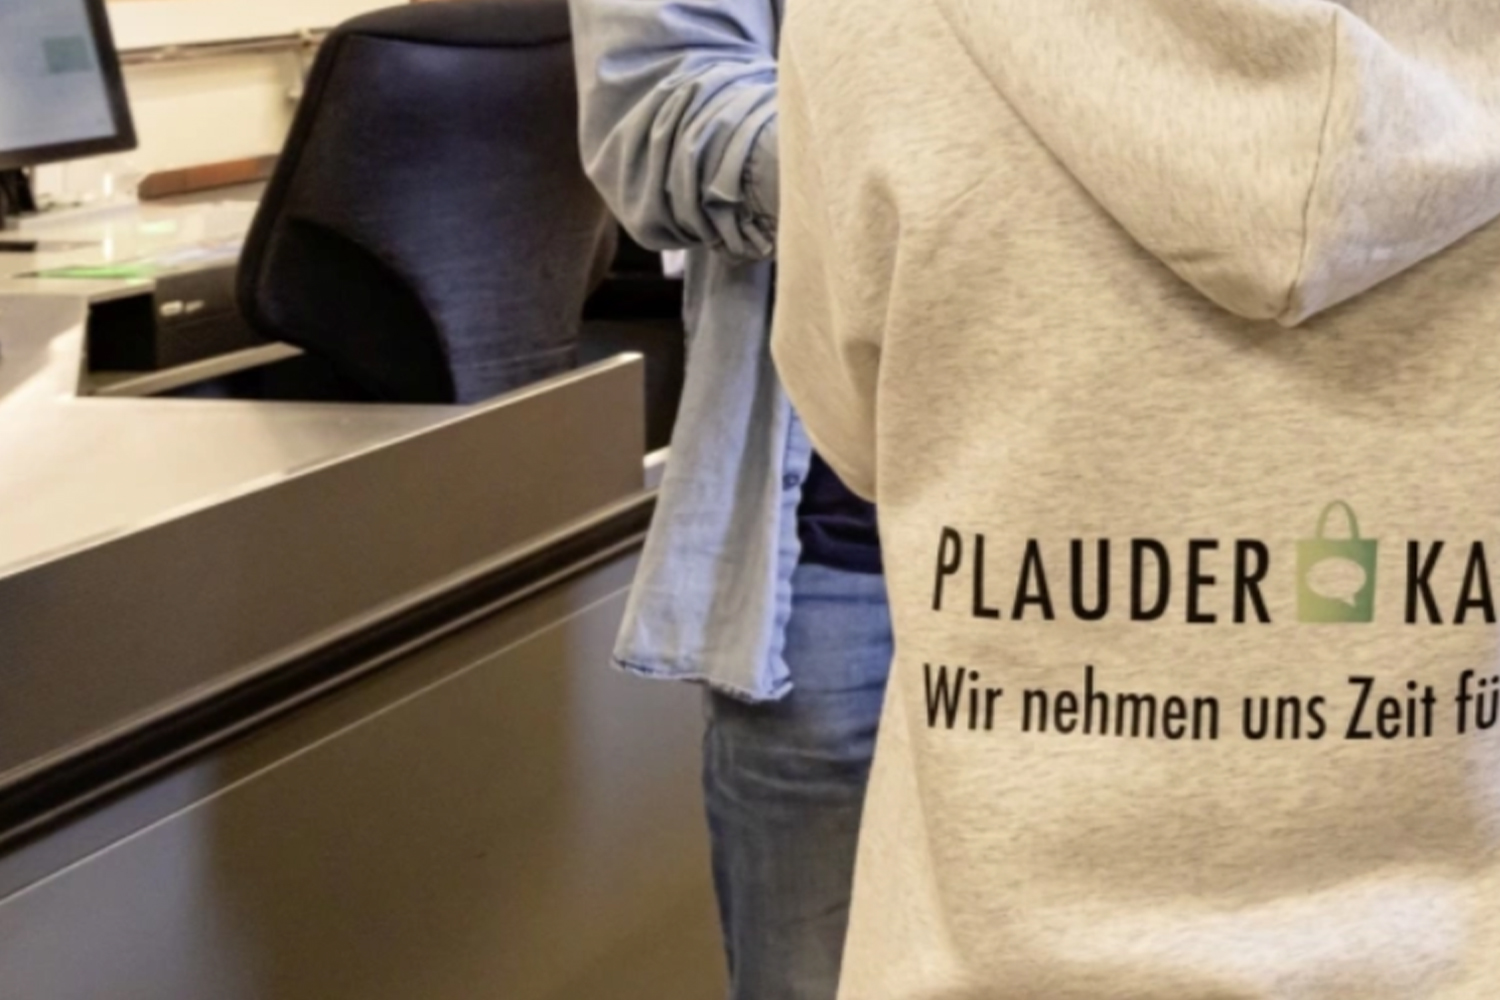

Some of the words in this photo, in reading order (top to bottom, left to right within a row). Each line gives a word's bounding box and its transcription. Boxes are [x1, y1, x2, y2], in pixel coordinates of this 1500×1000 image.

[931, 526, 1273, 624] PLAUDER
[923, 663, 1003, 731] Wir
[1021, 664, 1220, 740] nehmen
[1241, 694, 1327, 740] uns
[1344, 676, 1437, 740] Zeit
